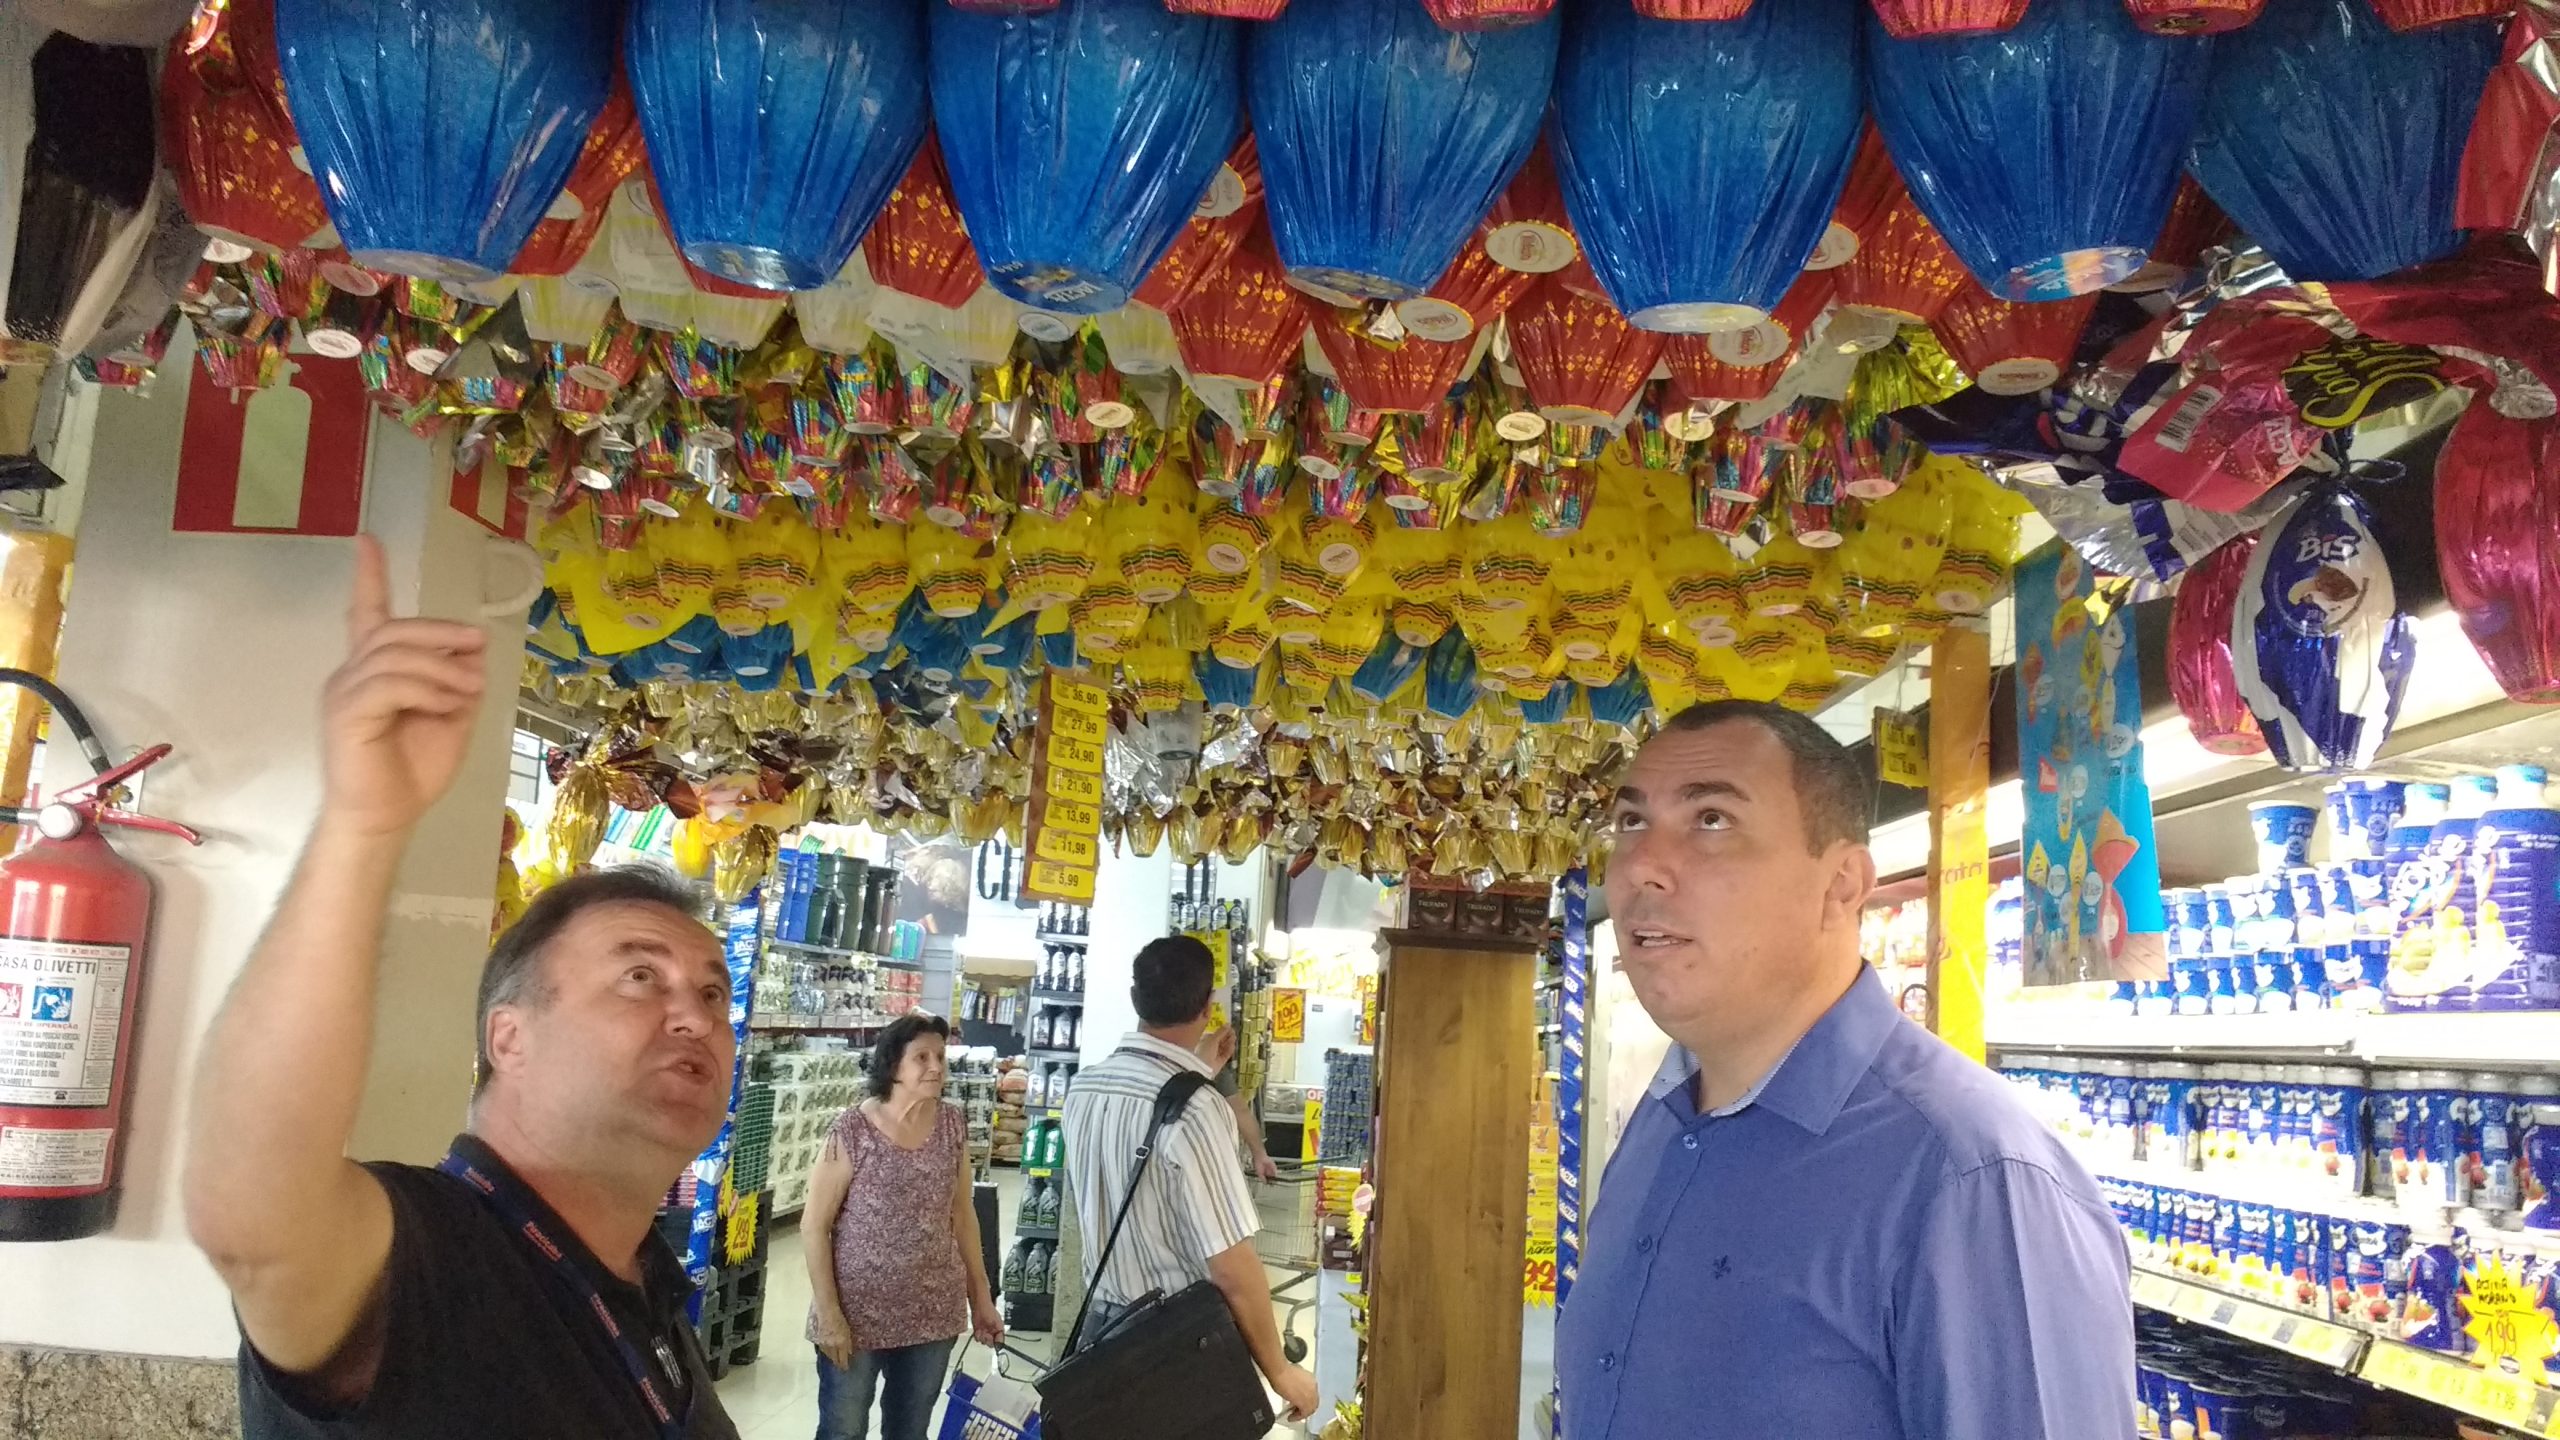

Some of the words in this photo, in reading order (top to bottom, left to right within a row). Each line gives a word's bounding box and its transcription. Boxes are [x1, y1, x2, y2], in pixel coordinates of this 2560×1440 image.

[1071, 719, 1097, 734] 27,99
[1069, 748, 1094, 763] 24,90
[1067, 779, 1092, 794] 21,90
[1066, 809, 1090, 824] 13,99
[1062, 840, 1086, 855] 11,98
[34, 958, 97, 975] OLIVETTI
